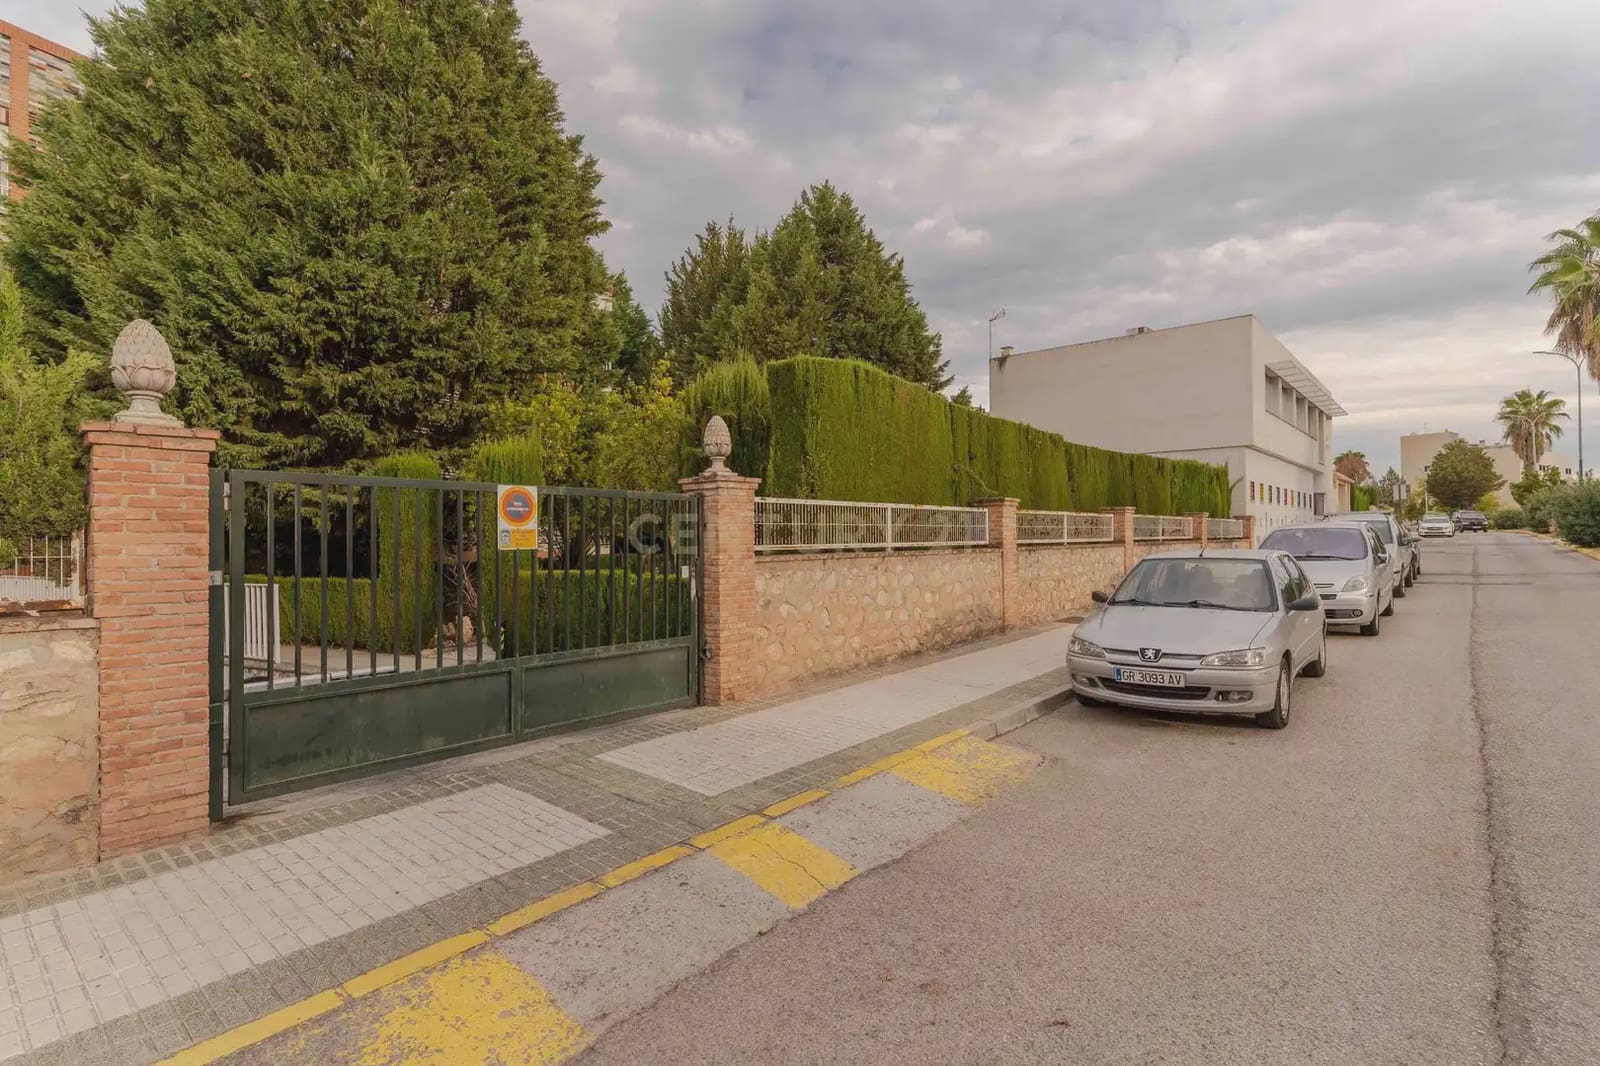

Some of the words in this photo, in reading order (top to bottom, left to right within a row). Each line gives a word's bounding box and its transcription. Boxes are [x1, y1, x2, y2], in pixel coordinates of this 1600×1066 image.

[1122, 670, 1136, 682] GR
[1138, 672, 1165, 684] 3093
[1167, 674, 1182, 686] AV
